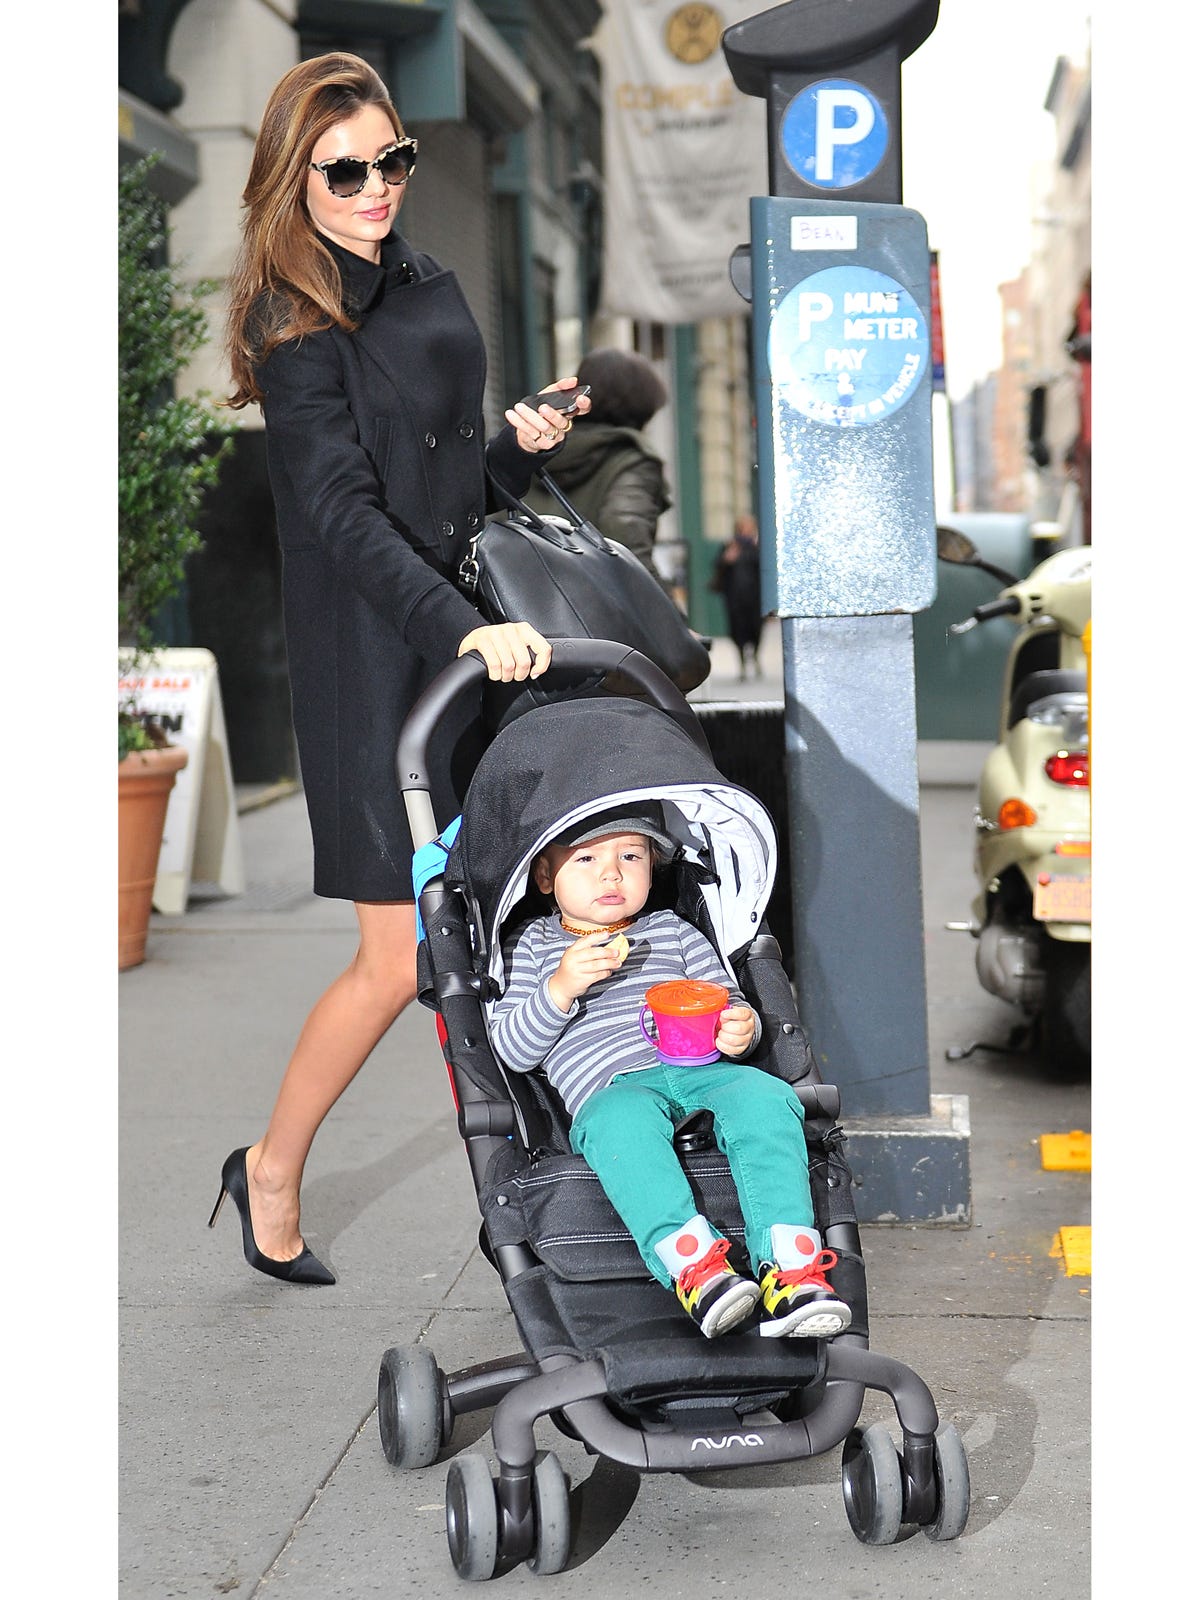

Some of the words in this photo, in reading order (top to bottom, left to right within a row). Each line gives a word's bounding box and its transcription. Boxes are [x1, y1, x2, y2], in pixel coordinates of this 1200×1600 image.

[815, 89, 875, 180] P
[800, 221, 846, 243] BEAN
[844, 292, 899, 314] MUNI
[799, 292, 834, 341] P
[844, 317, 918, 340] METER
[824, 348, 868, 370] PAY
[691, 1434, 764, 1451] nuna
